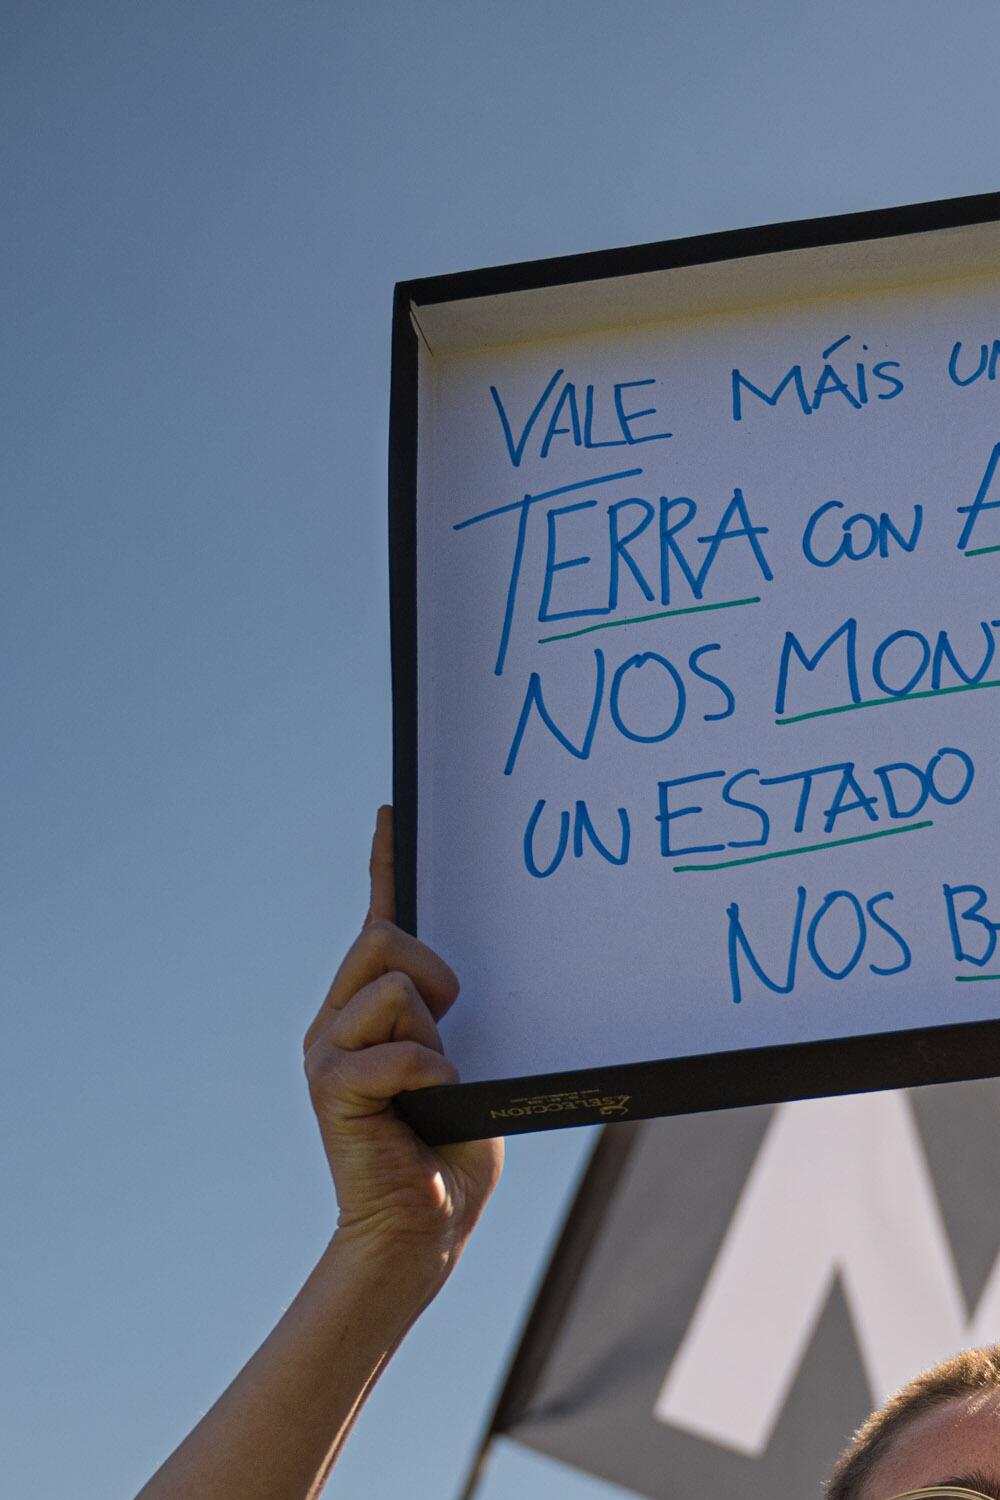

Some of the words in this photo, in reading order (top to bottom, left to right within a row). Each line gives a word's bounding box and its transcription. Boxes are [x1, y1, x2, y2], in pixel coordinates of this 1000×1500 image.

[490, 368, 673, 467] VALE
[452, 467, 775, 677] TERRA
[802, 500, 923, 568] CON
[503, 642, 736, 776] NOS
[523, 799, 631, 879] UN
[655, 746, 975, 858] ESTADO
[726, 885, 912, 1004] NOS
